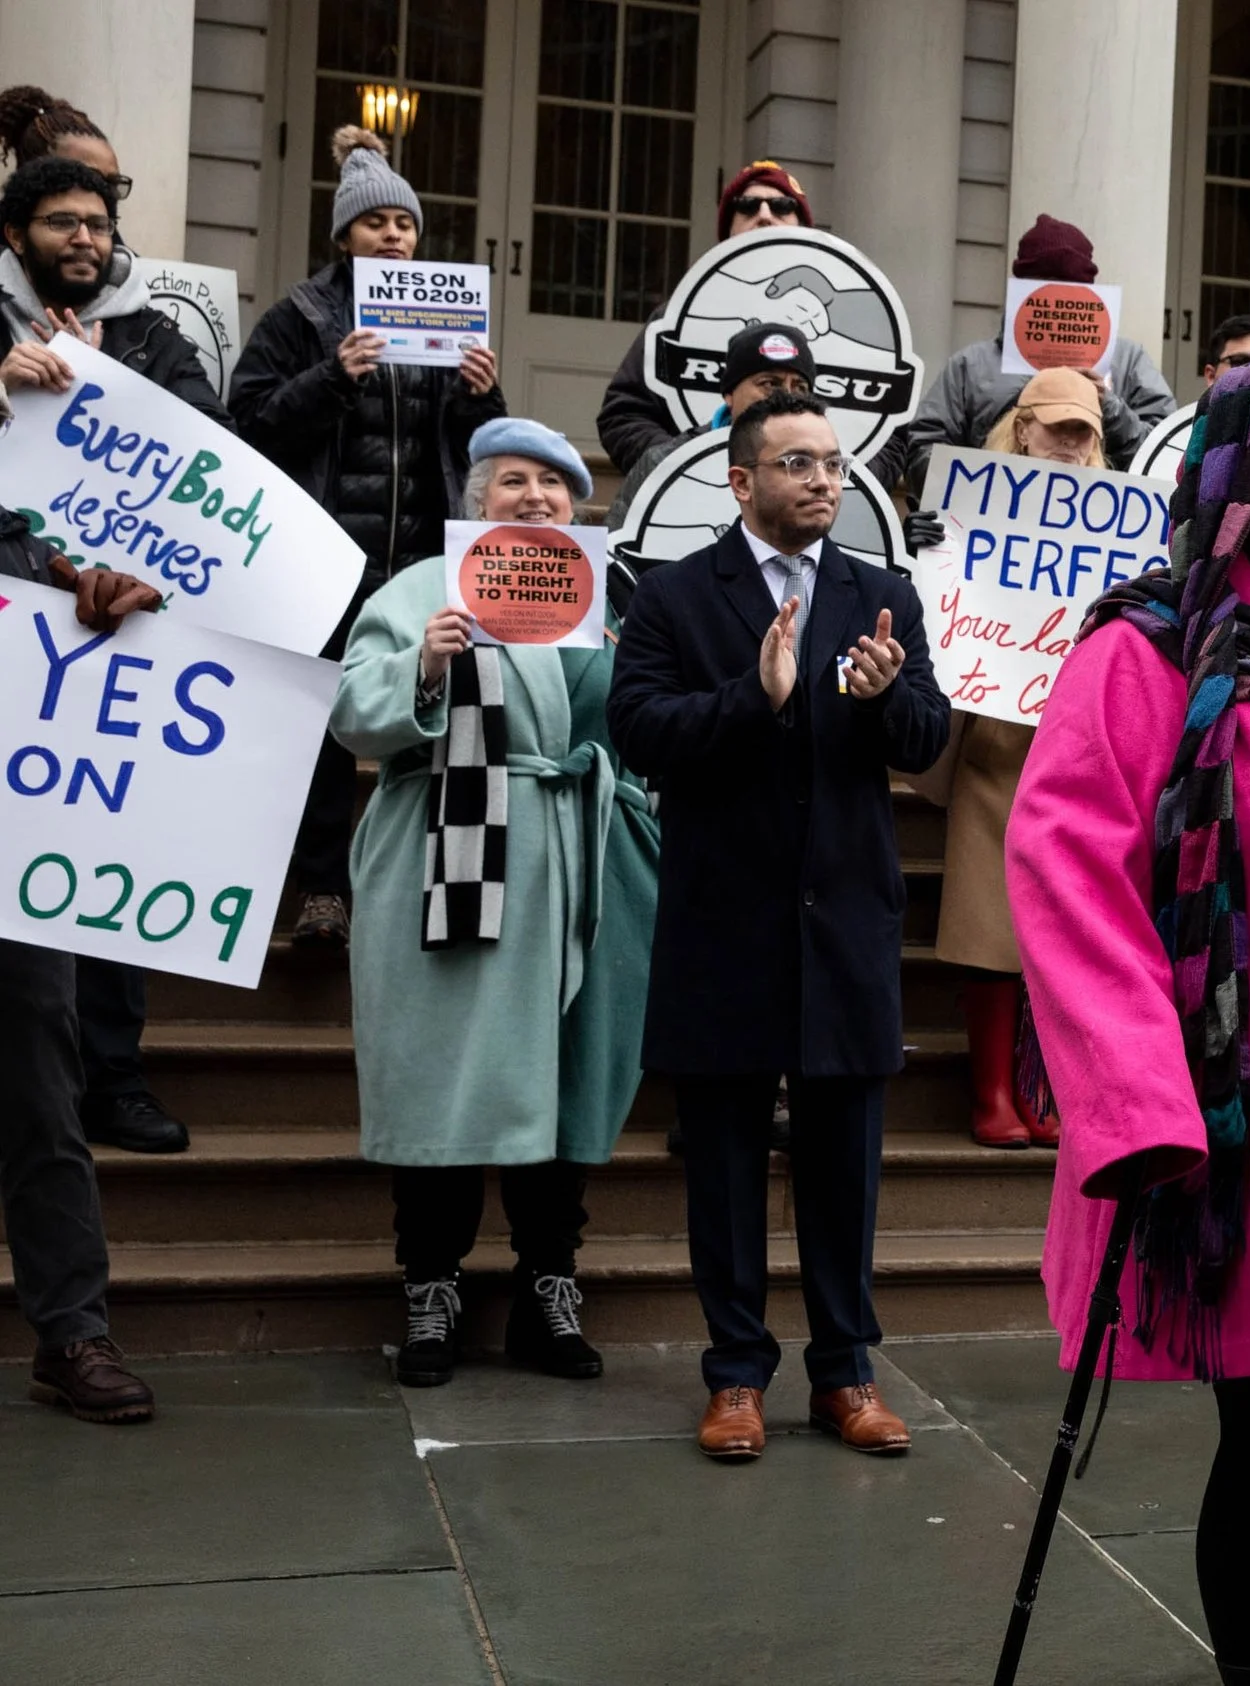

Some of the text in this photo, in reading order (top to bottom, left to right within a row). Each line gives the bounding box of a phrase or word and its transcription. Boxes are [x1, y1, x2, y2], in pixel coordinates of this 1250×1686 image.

[381, 270, 465, 288] YES ON
[369, 286, 481, 305] INT 0209!
[1026, 298, 1105, 312] ALL BODIES
[196, 282, 233, 353] Project
[1033, 310, 1095, 323] DESERVE
[1026, 321, 1100, 334] THE RIGHT
[1025, 332, 1102, 345] TO THRIVE!
[49, 479, 222, 596] deserves
[471, 545, 582, 560] ALL BODIES
[483, 560, 568, 574] DESERVE
[475, 574, 575, 589] THE RIGHT
[475, 588, 578, 604] TO THRIVE!
[33, 611, 235, 756] YES
[950, 657, 1001, 704] to
[6, 745, 136, 813] ON
[18, 852, 254, 963] 0209
